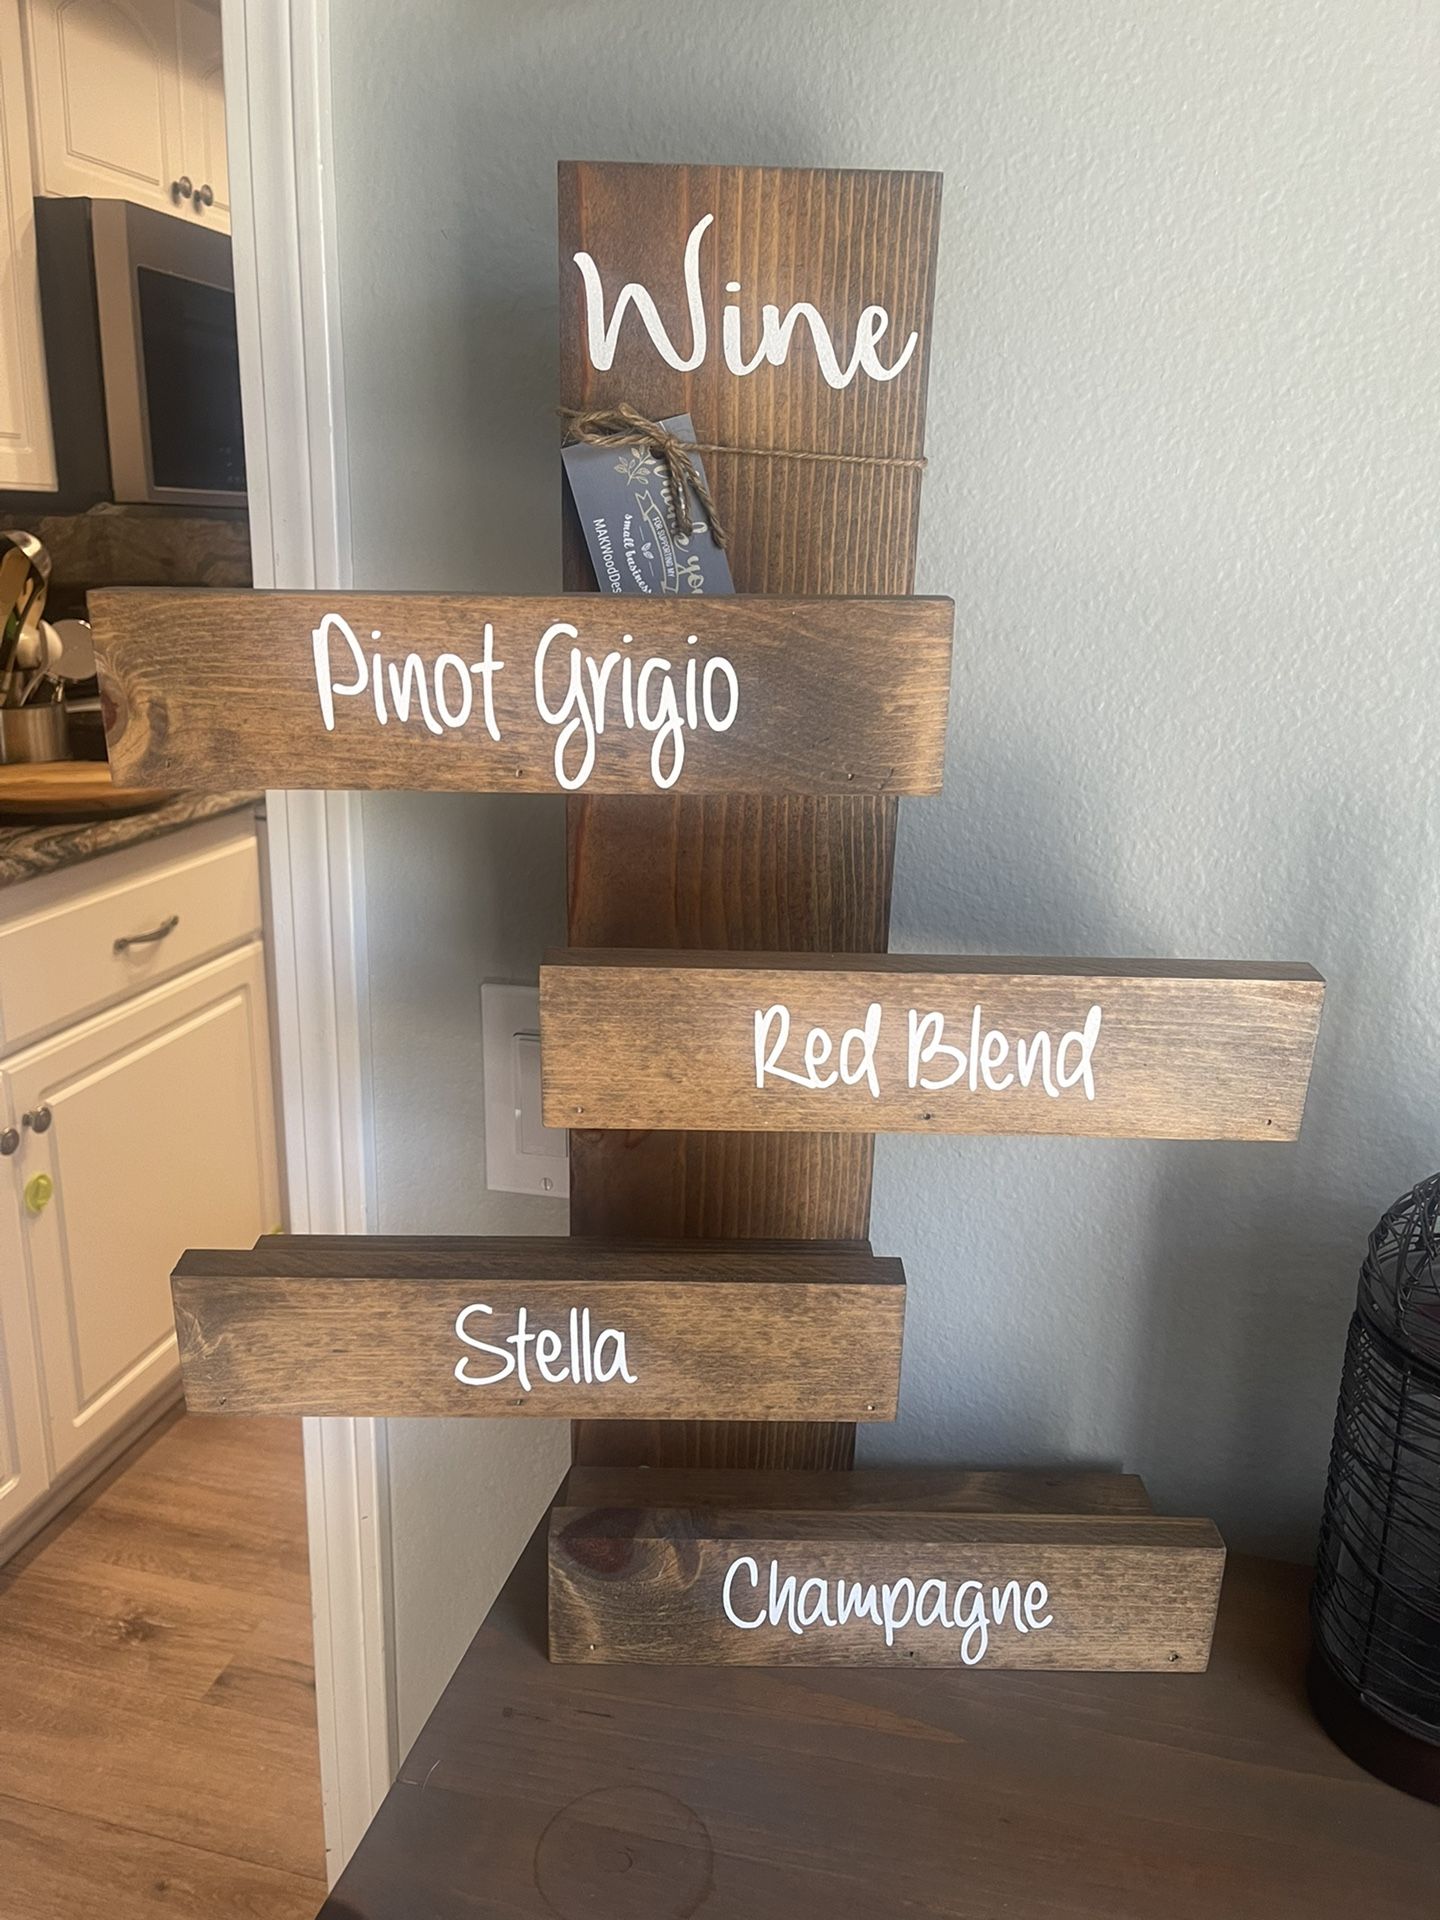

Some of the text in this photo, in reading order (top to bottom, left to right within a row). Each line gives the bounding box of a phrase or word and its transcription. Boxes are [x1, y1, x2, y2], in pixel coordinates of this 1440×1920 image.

[573, 214, 918, 389] Wine
[623, 513, 635, 550] small
[652, 516, 676, 578] FOR SUPPORTING MY
[312, 613, 739, 790] Pinot Grigio
[754, 1003, 1102, 1101] Red Blend
[453, 1304, 638, 1388] Stella
[723, 1557, 1053, 1665] Champagne
